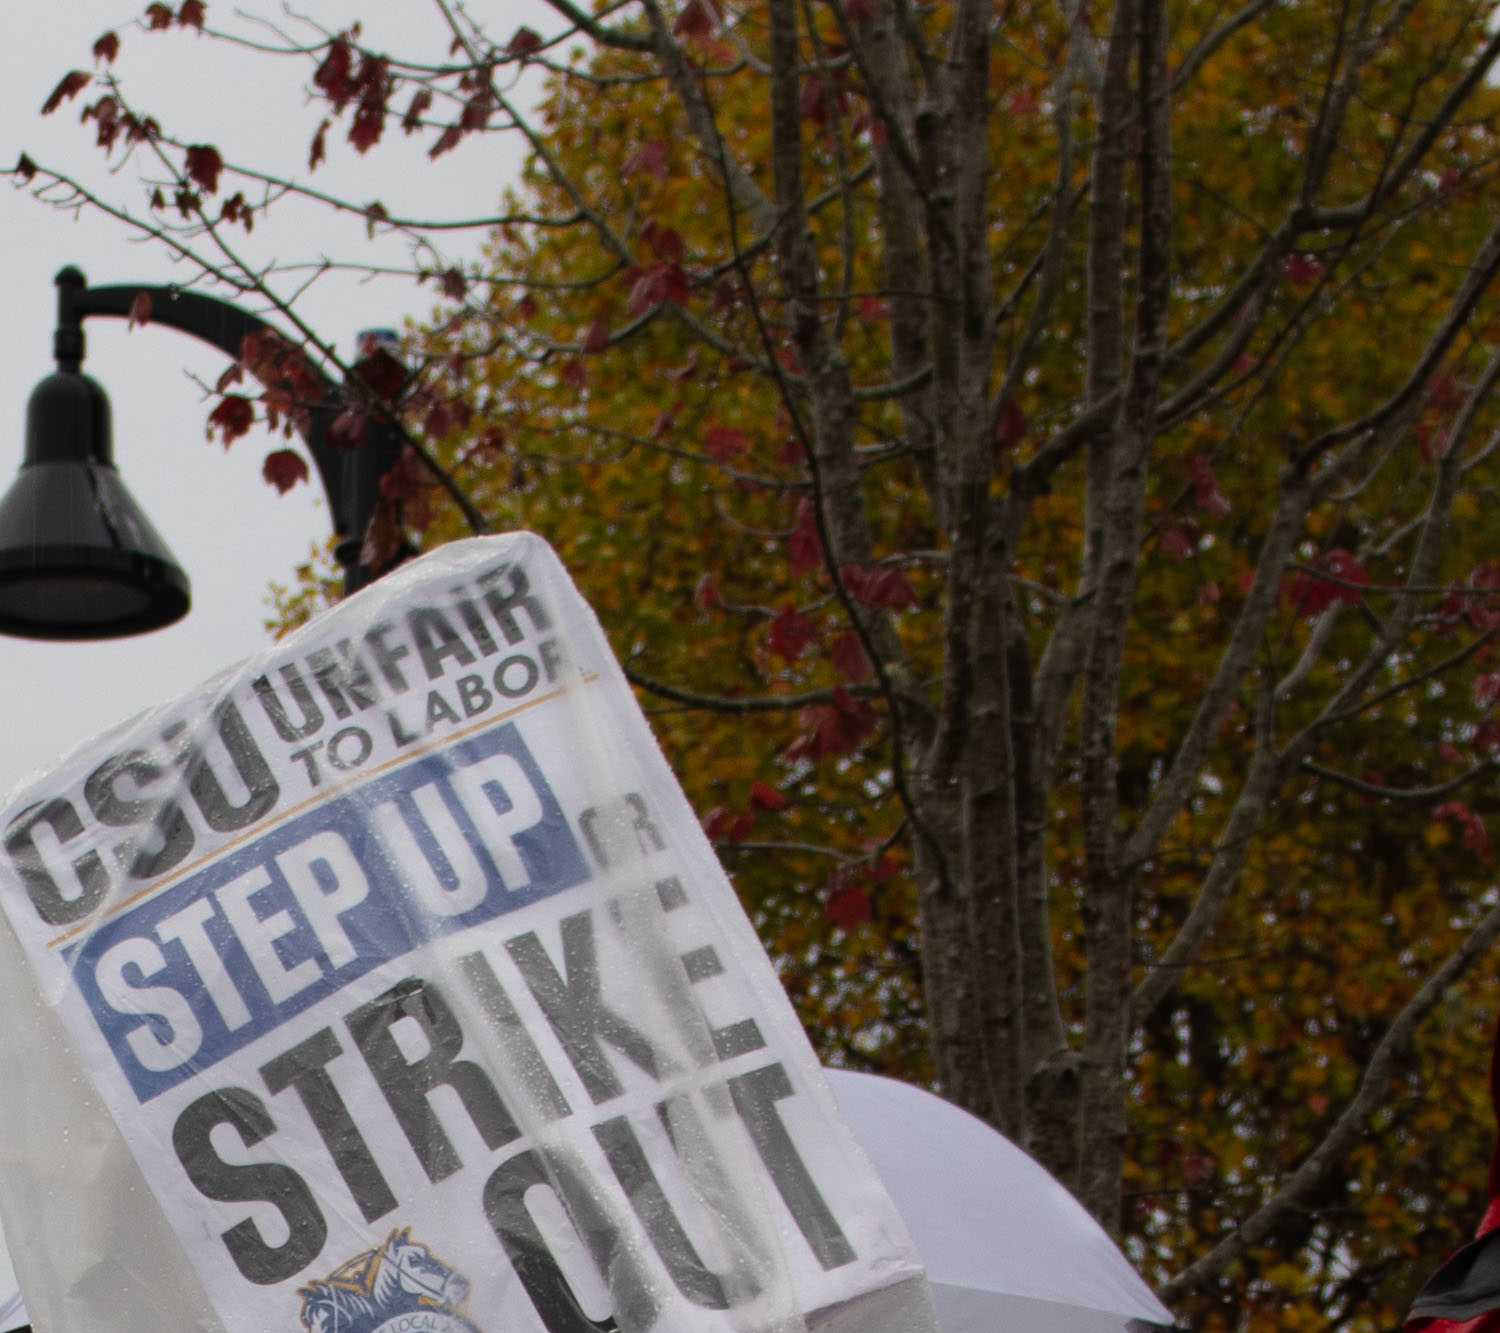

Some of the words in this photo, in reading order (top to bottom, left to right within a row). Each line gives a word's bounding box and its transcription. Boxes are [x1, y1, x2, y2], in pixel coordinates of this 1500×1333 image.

[251, 562, 554, 743] UNFAIR
[290, 726, 374, 789] TO
[4, 698, 280, 926] CSU
[93, 830, 370, 1074] STEP
[376, 753, 544, 919] UP
[171, 874, 768, 1285] STRIKE
